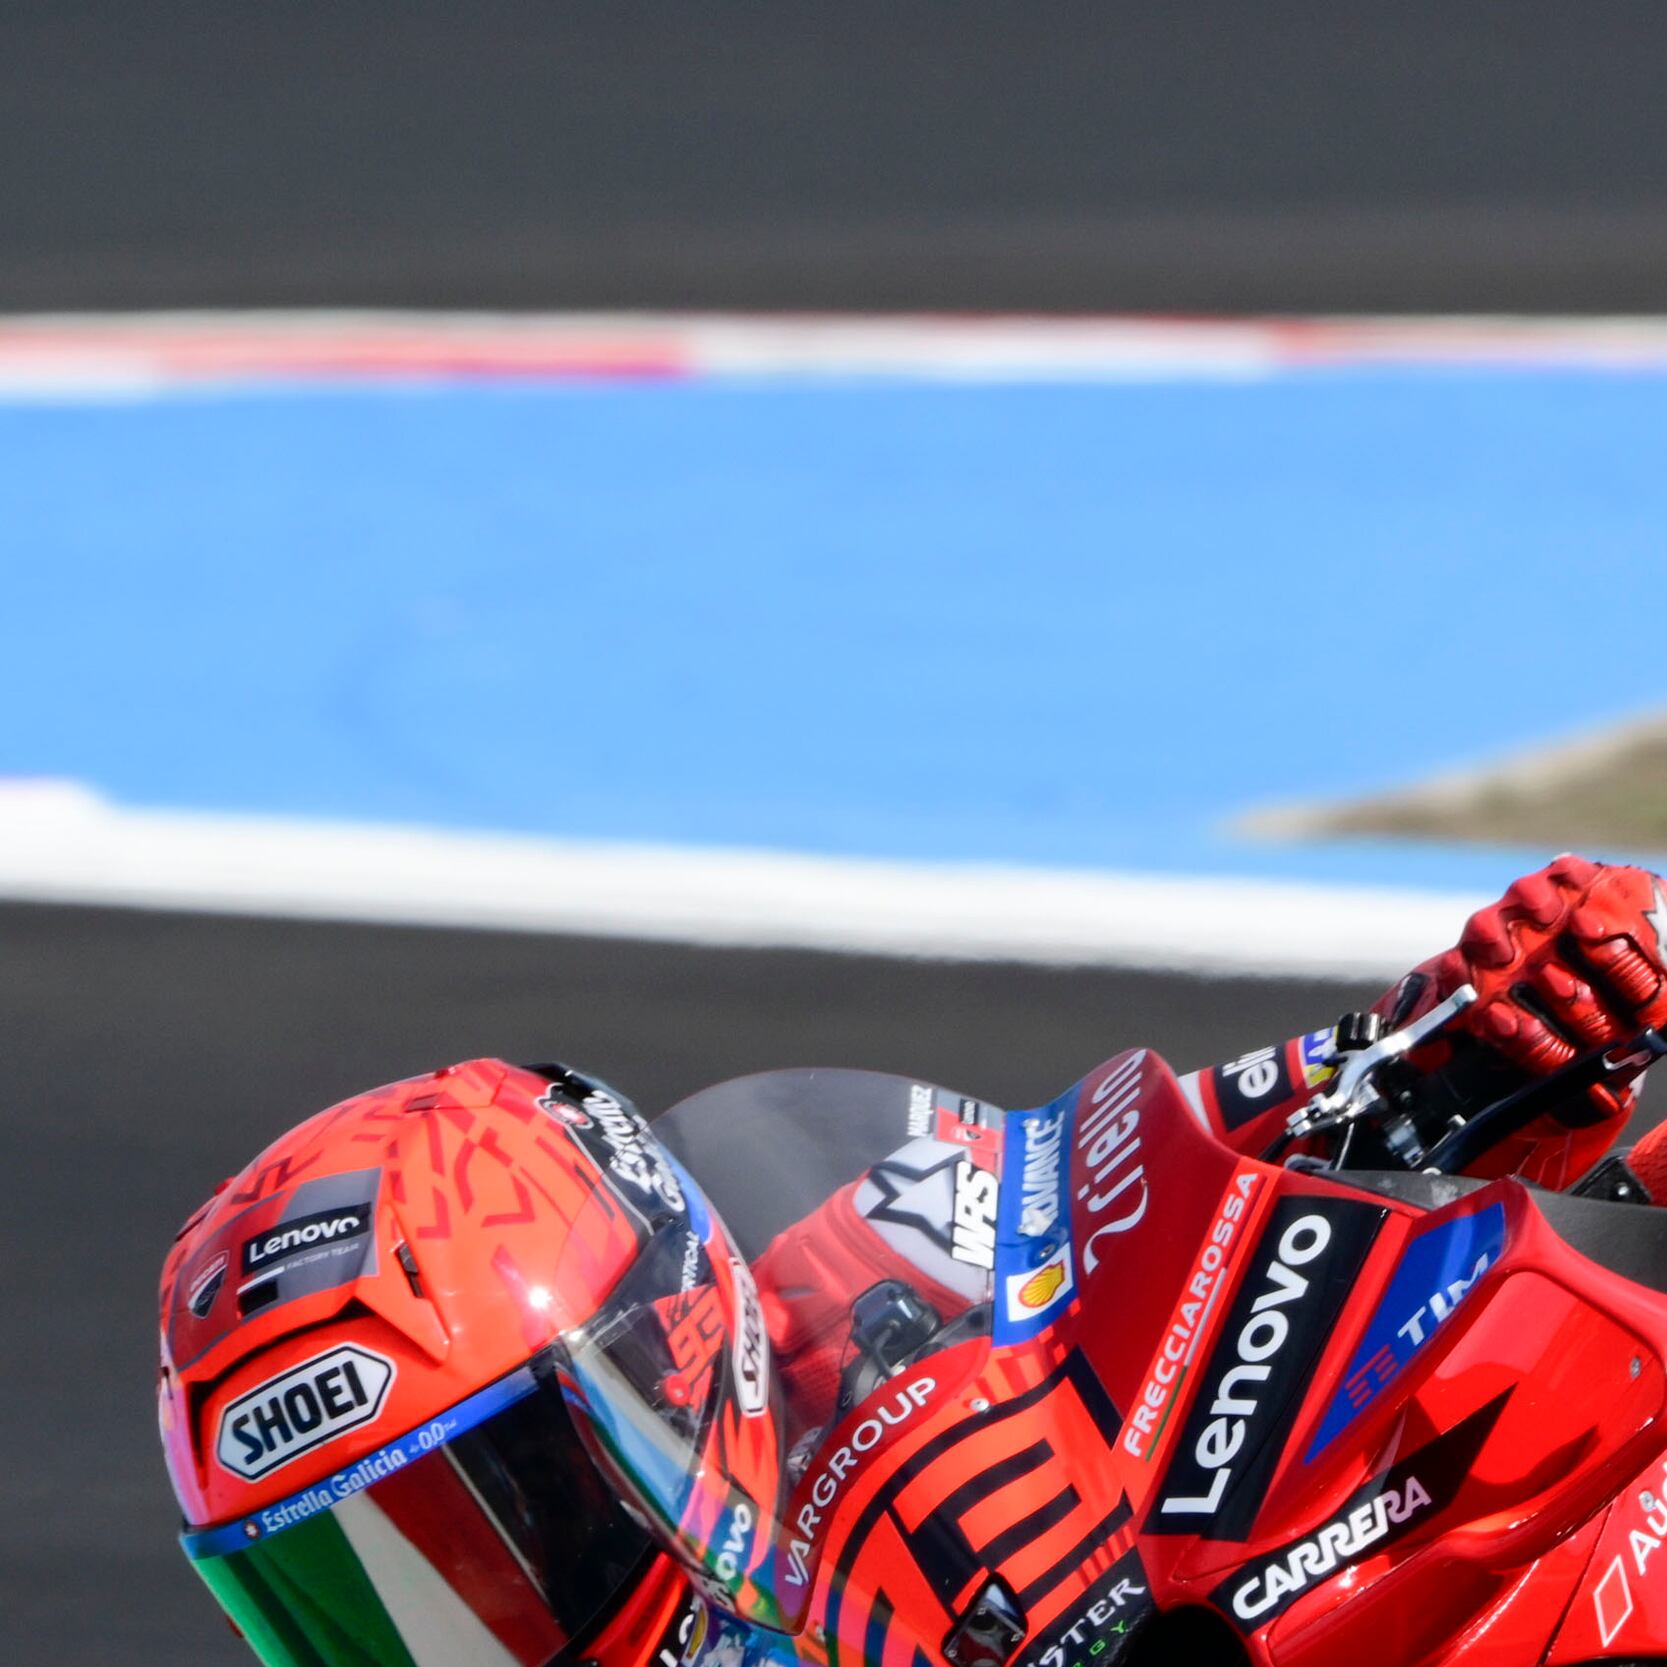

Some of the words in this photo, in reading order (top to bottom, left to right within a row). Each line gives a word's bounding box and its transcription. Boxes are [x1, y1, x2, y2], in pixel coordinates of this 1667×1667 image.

[249, 1216, 360, 1264] Lenovo
[952, 1160, 999, 1271] WRS
[1124, 1172, 1259, 1458] FRECCIAROSSA
[1398, 1252, 1490, 1346] TIM
[232, 1360, 369, 1465] SHOEI
[1161, 1214, 1332, 1514] Lenovo
[262, 1490, 334, 1534] Estrella
[331, 1447, 408, 1496] Galicia
[784, 1376, 938, 1587] VARGROUP
[1232, 1475, 1433, 1611] CARRERA
